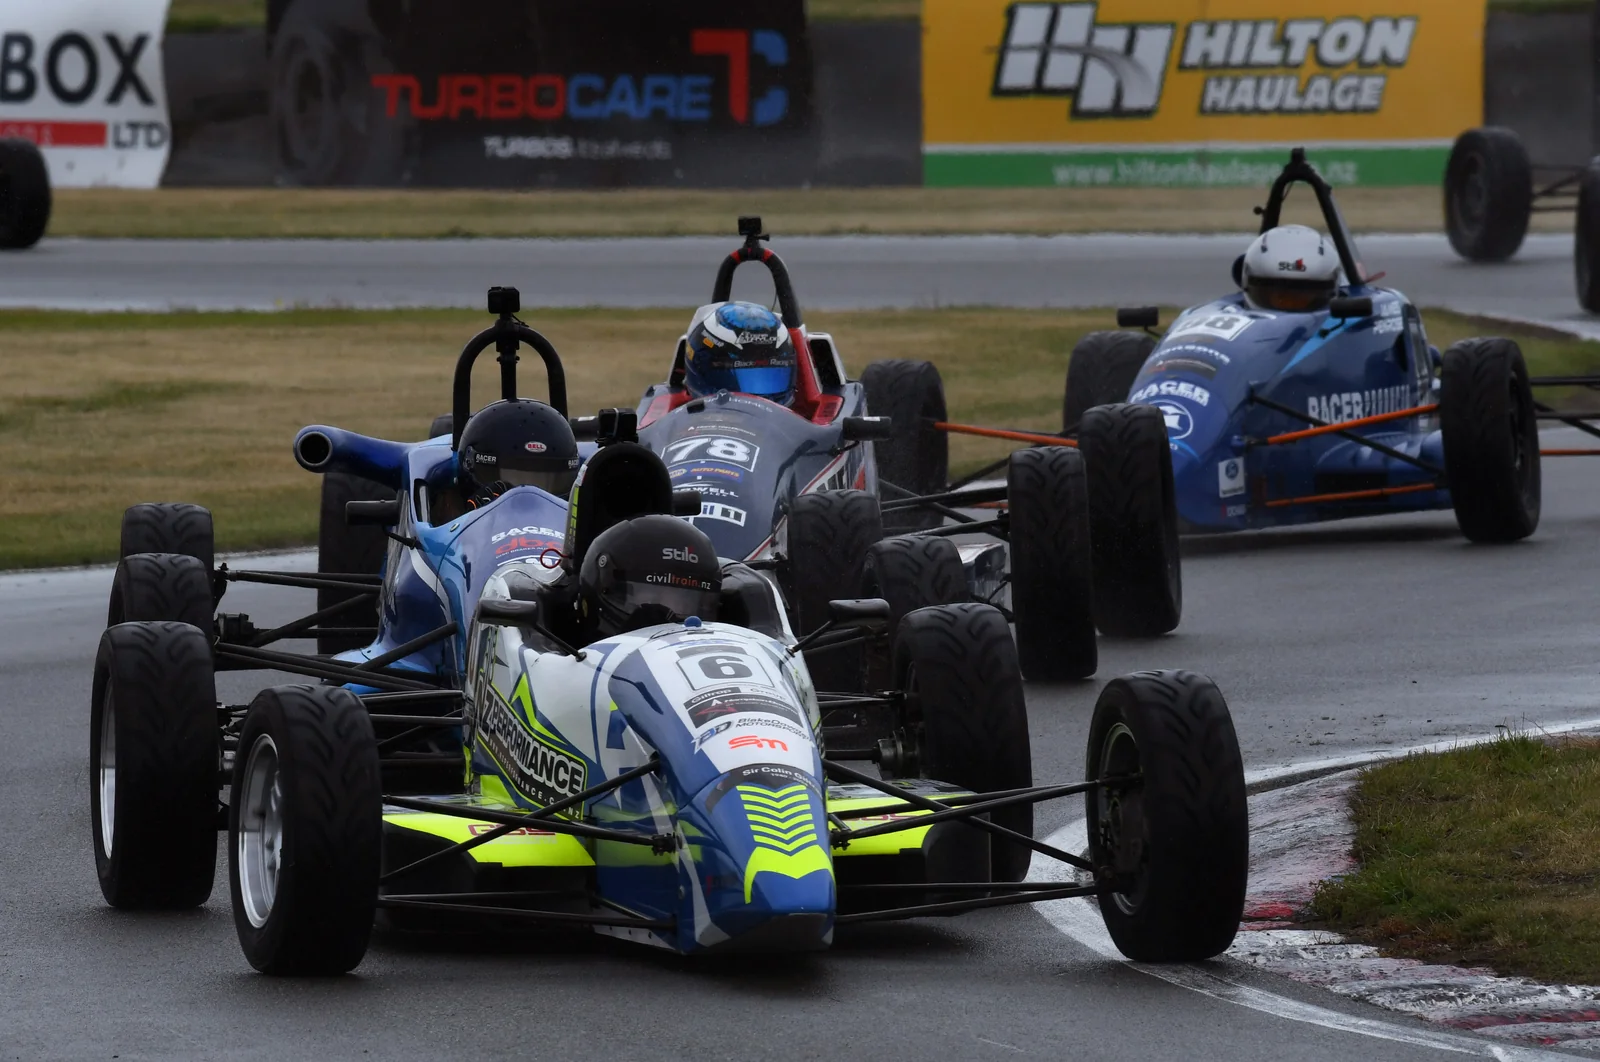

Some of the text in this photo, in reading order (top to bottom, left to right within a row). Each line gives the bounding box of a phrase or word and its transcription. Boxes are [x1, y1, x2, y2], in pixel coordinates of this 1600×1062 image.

[1181, 17, 1415, 68] HILTON
[1, 32, 156, 106] BOX
[371, 73, 714, 119] TURBOCARE
[1201, 75, 1385, 112] HAULAGE
[112, 121, 168, 149] LTD
[475, 453, 497, 462] RACER
[666, 437, 751, 464] 78
[662, 546, 699, 564] Stilo
[646, 573, 712, 590] civiltrain.nz
[697, 655, 753, 680] 6
[742, 767, 759, 776] Sir
[761, 766, 793, 776] Colin
